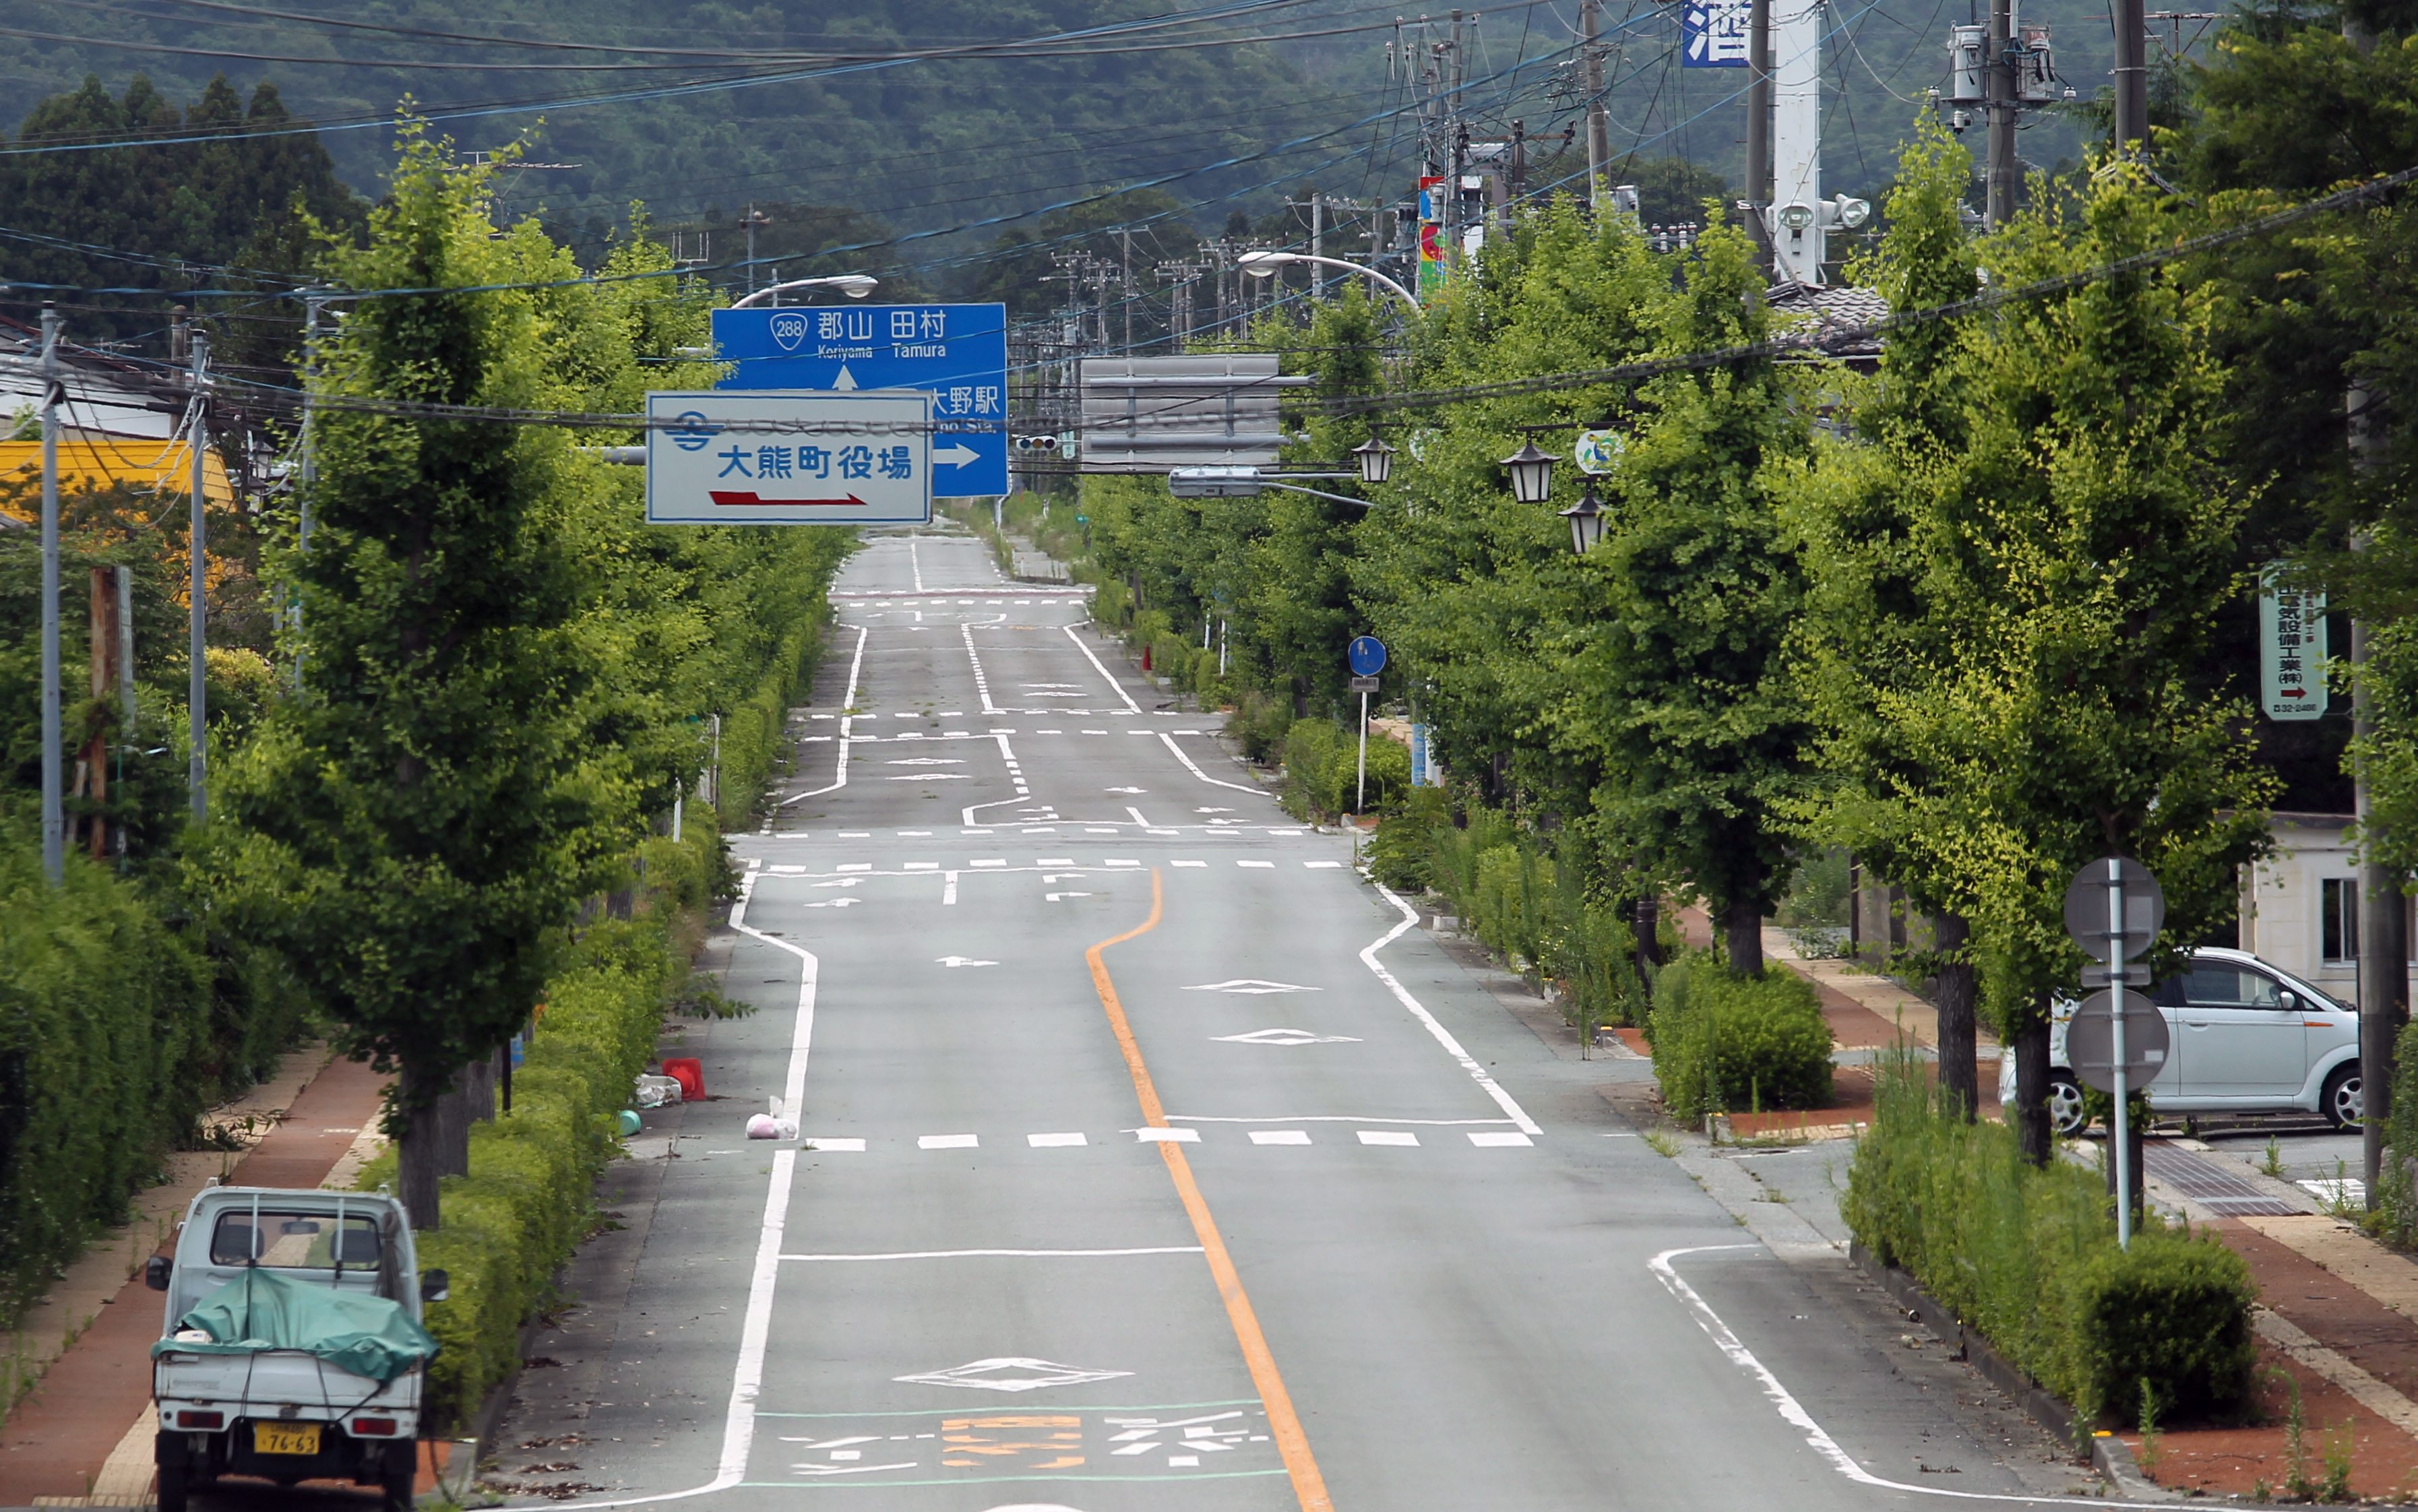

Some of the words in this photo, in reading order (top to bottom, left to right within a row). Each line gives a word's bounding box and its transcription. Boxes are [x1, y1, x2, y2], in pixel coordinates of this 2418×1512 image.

[776, 321, 803, 338] 288
[818, 312, 872, 340] 郡山
[891, 309, 946, 339] 田村
[892, 342, 946, 358] Tamura
[718, 445, 912, 479] 大熊町役場
